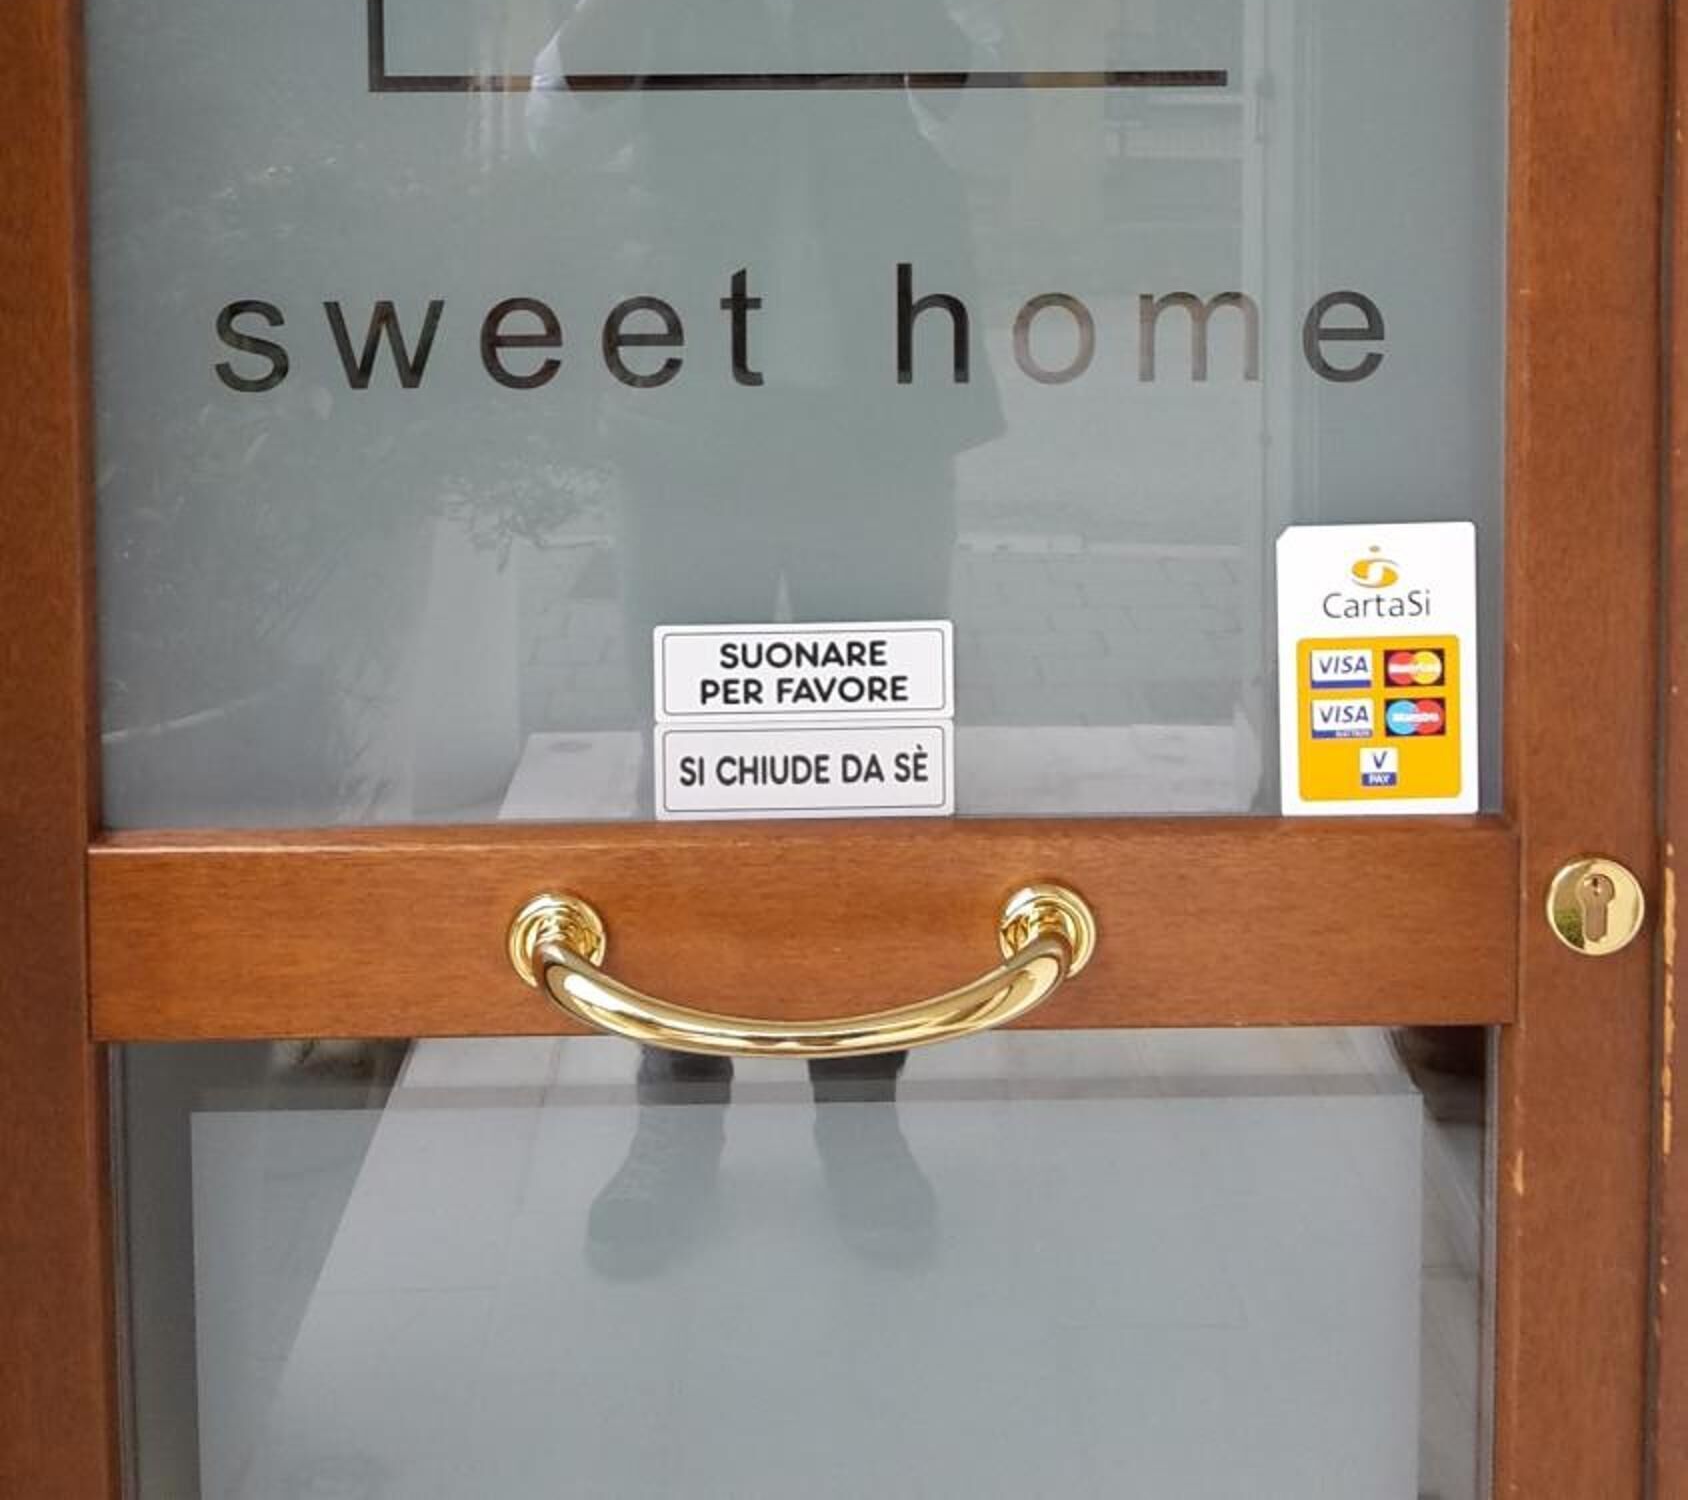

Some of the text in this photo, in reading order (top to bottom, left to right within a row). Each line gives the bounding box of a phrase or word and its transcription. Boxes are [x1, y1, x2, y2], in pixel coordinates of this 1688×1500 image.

[212, 263, 1387, 393] sweet home
[1322, 590, 1431, 619] CartaSi
[719, 640, 888, 669] SUONARE
[1318, 655, 1369, 674] VISA
[700, 675, 909, 705] PER FAVORE
[1319, 705, 1369, 723] VISA
[680, 743, 929, 786] SI CHIUDE DA SÈ
[1372, 750, 1388, 769] V
